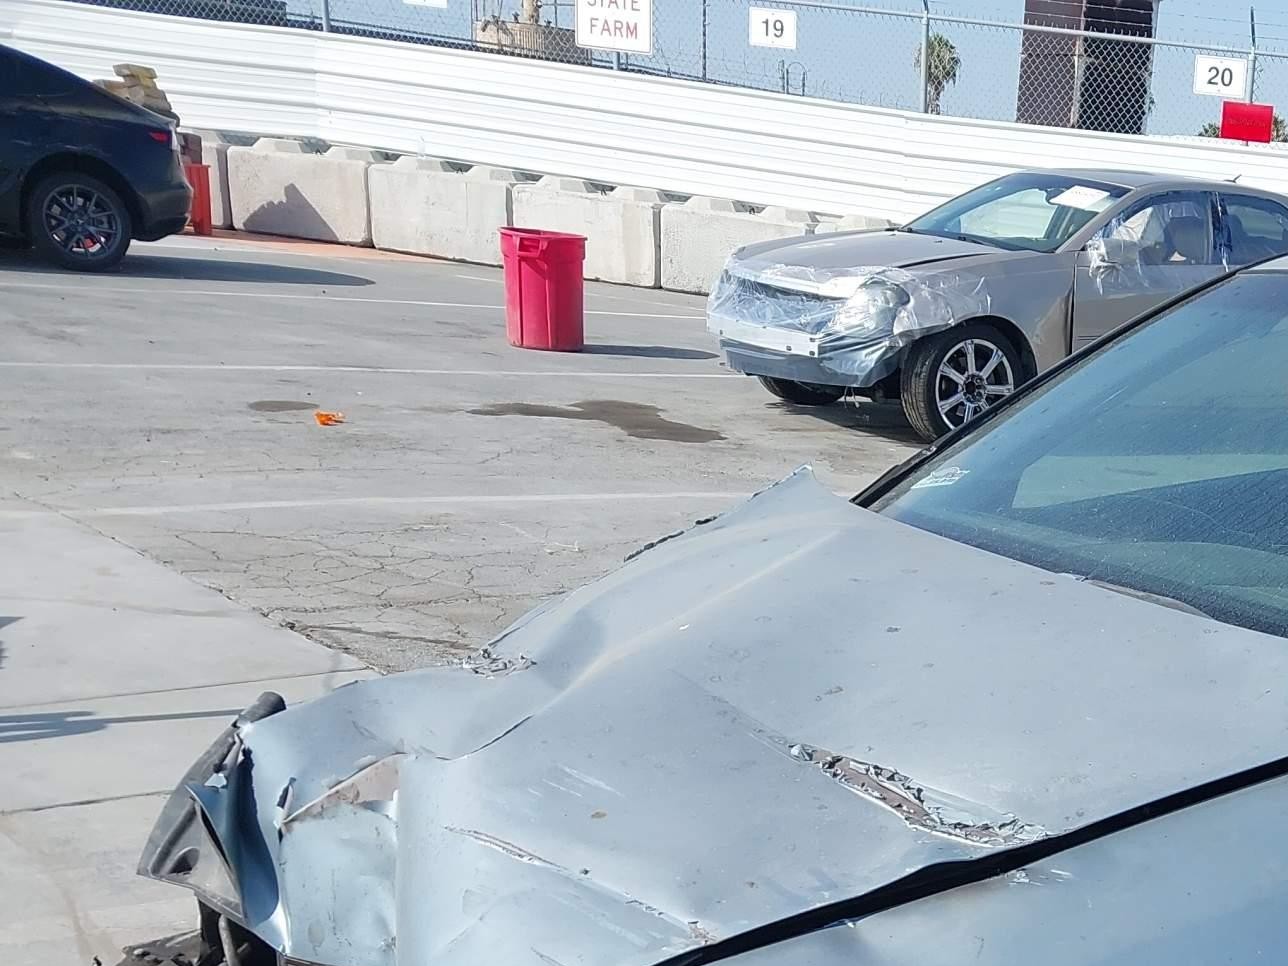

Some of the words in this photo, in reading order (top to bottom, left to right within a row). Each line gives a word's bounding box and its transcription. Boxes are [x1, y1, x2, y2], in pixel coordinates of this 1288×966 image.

[590, 17, 638, 40] FARM
[761, 18, 785, 38] 19
[1206, 66, 1233, 87] 20
